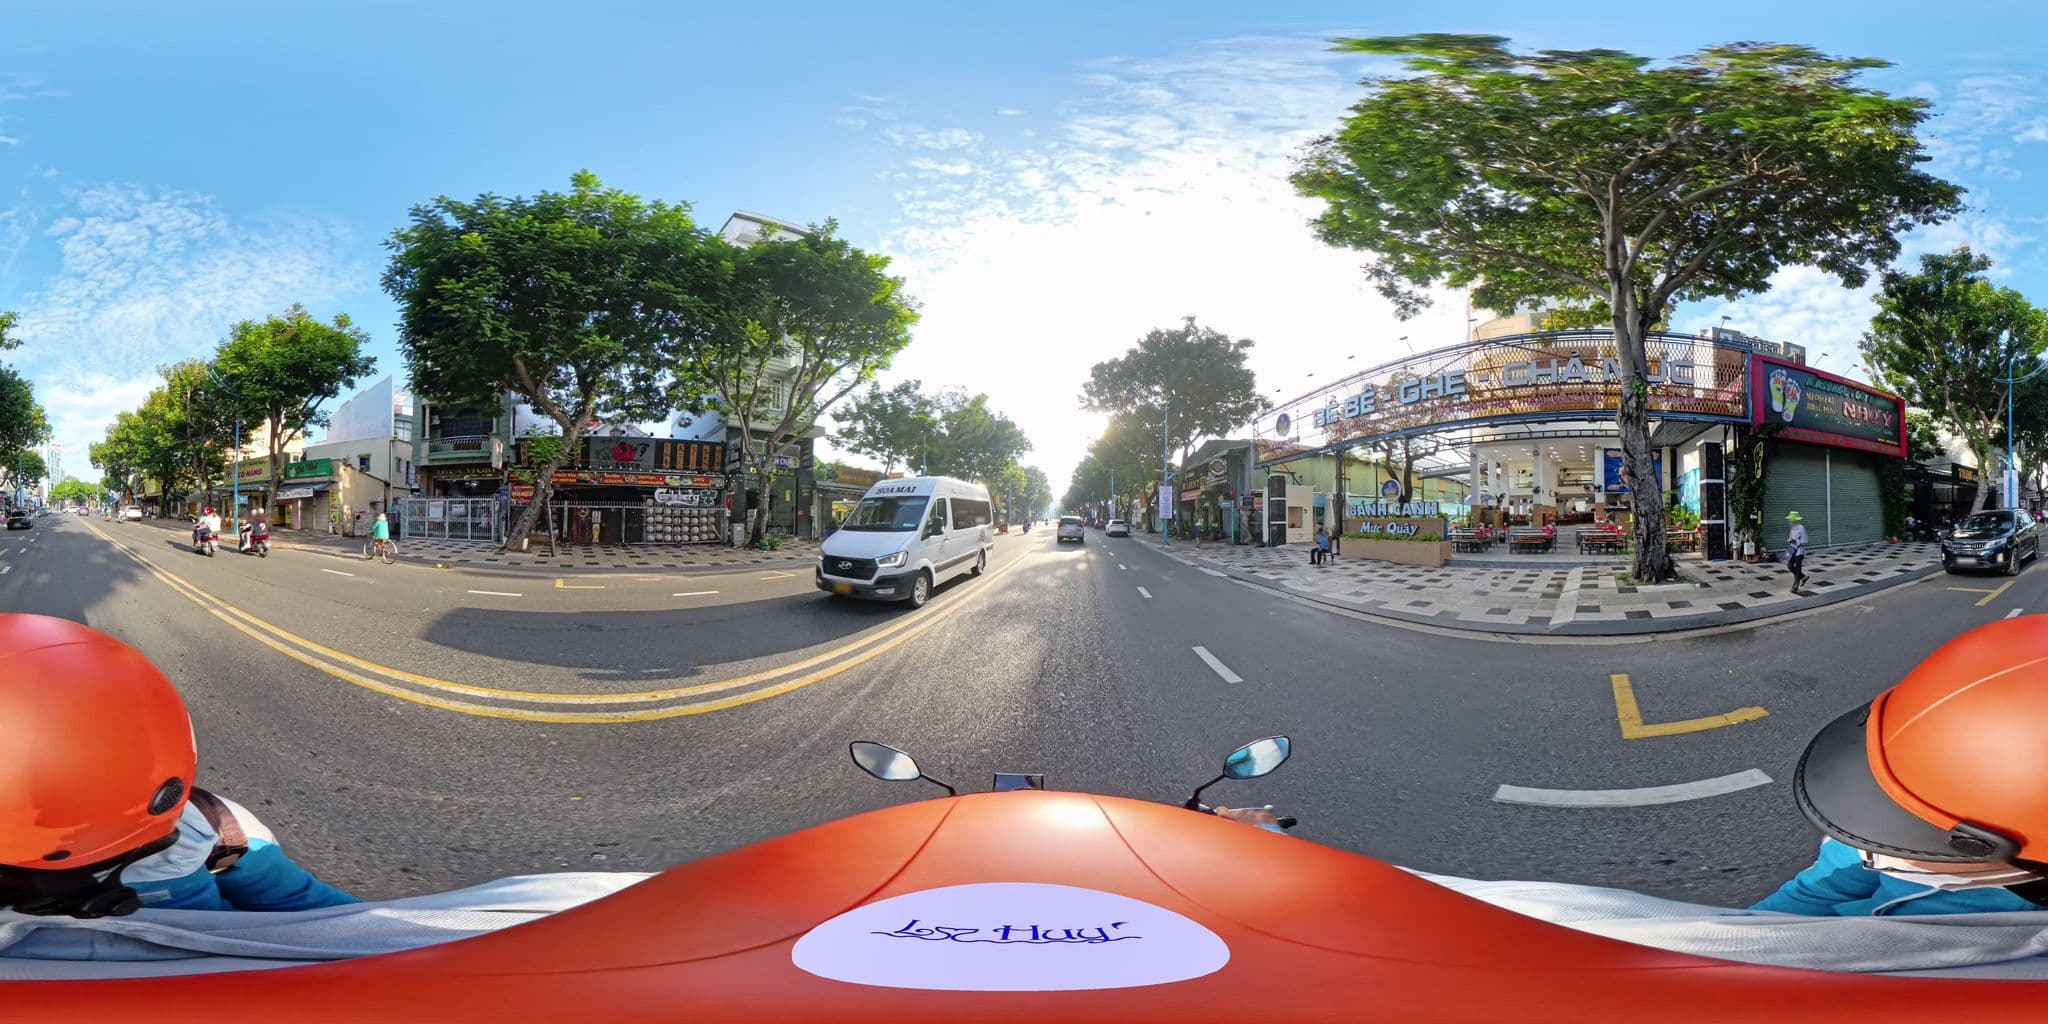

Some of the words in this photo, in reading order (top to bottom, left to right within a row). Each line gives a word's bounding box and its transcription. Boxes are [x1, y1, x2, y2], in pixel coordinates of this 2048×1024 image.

[1503, 350, 1593, 387] CHẢ
[1350, 500, 1388, 516] BÁNH
[1391, 501, 1438, 516] CANH
